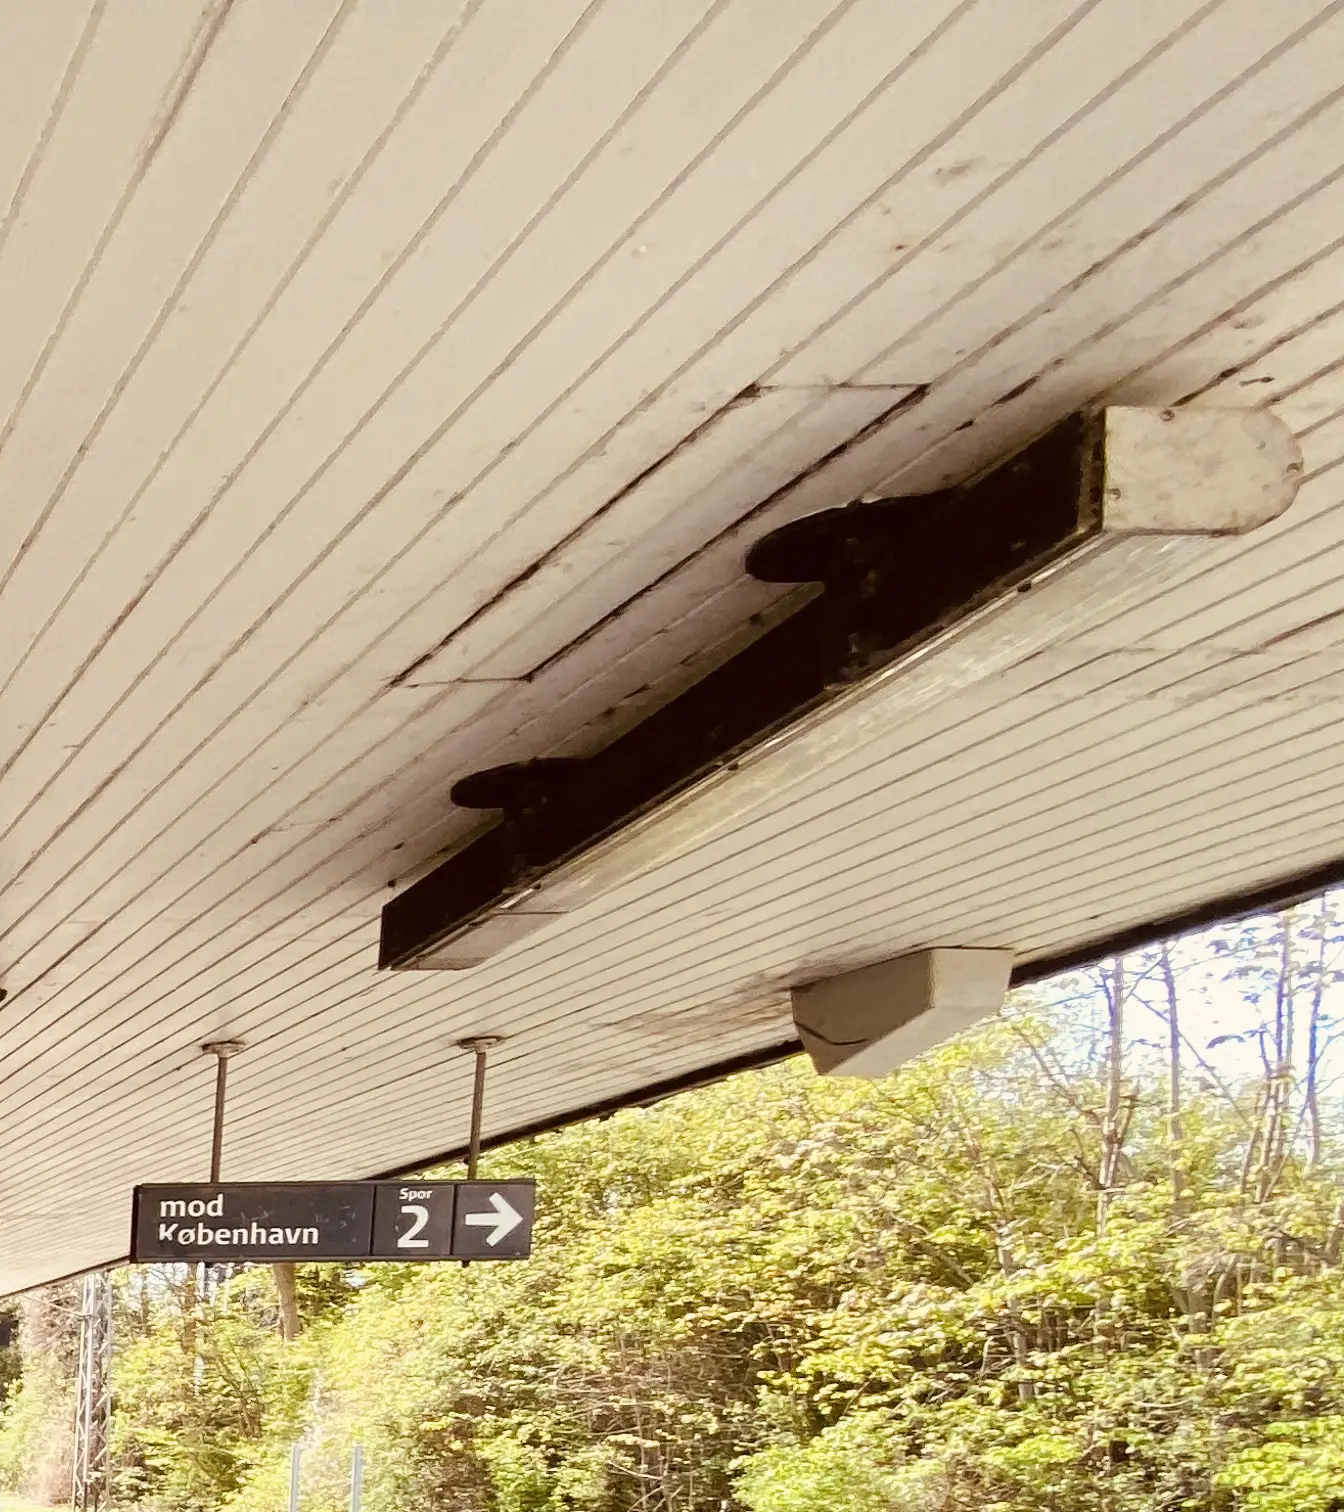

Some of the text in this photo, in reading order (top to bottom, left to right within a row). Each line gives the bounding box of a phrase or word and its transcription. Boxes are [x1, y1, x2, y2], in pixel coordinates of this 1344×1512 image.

[159, 1194, 224, 1218] mod
[398, 1187, 433, 1201] Spor
[159, 1222, 319, 1246] København
[396, 1204, 430, 1248] 2
